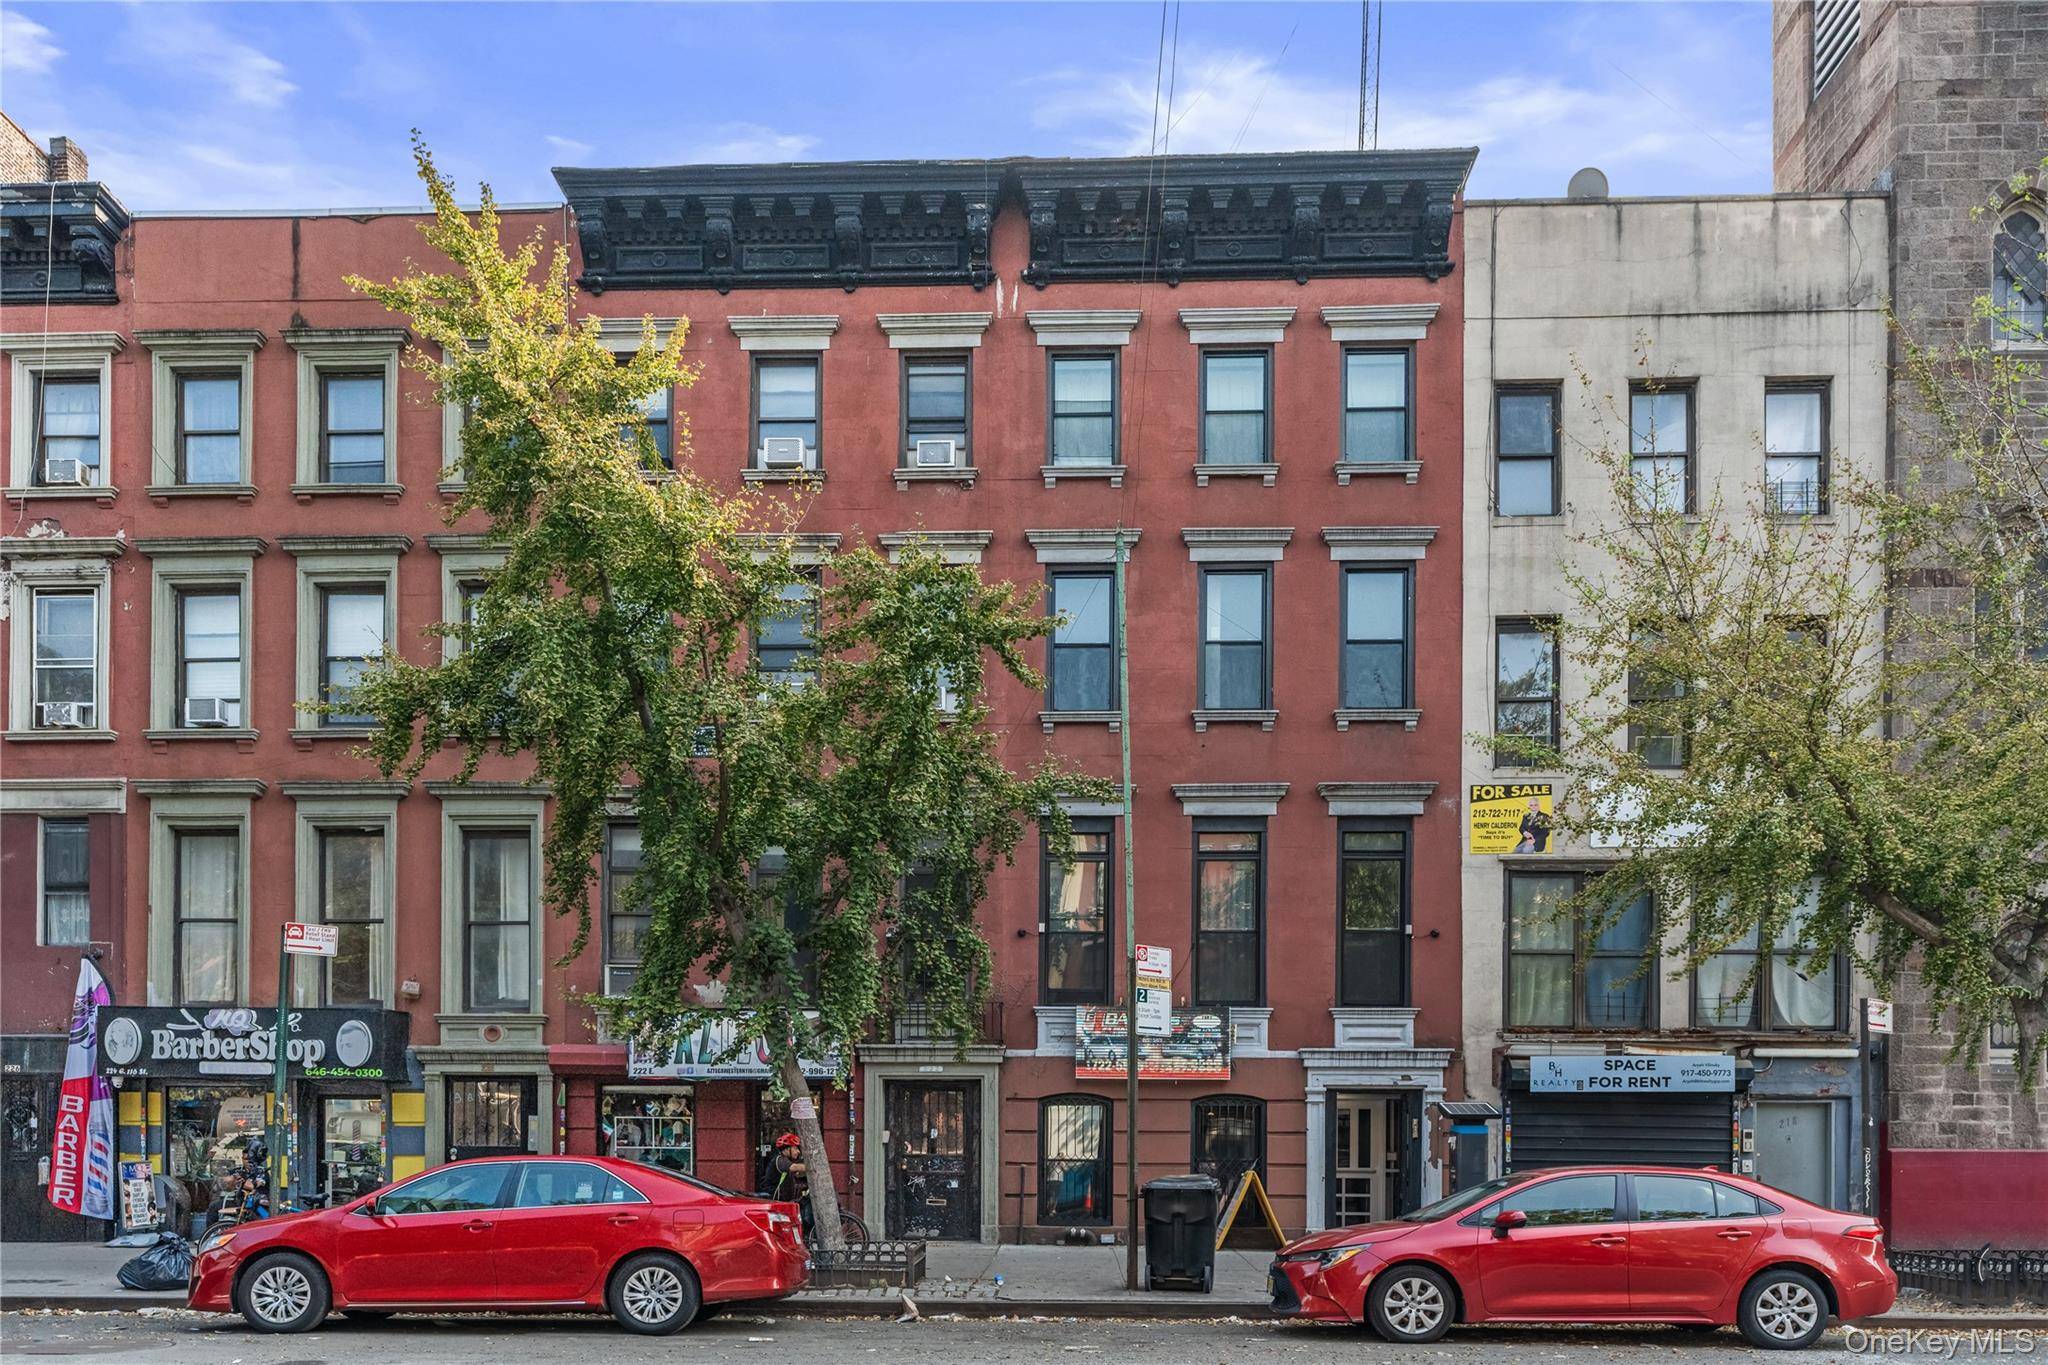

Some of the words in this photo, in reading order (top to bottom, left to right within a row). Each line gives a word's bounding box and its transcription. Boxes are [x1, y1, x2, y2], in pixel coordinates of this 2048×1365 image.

[1472, 785, 1506, 800] FOR
[1511, 785, 1550, 797] SALE
[1472, 809, 1521, 818] 212-722-7117
[1139, 989, 1146, 1002] 2
[151, 1028, 325, 1068] BarberShop
[5, 1065, 20, 1073] 226
[1604, 1059, 1657, 1071] SPACE
[305, 1067, 383, 1077] 646-454-0300
[633, 1067, 648, 1075] 222
[801, 1067, 838, 1075] 2-996-12
[1680, 1069, 1732, 1077] 917-450-9773
[1533, 1079, 1576, 1087] REALTY
[1588, 1076, 1623, 1088] FOR
[1628, 1076, 1672, 1088] RENT
[52, 1094, 84, 1206] BARBER
